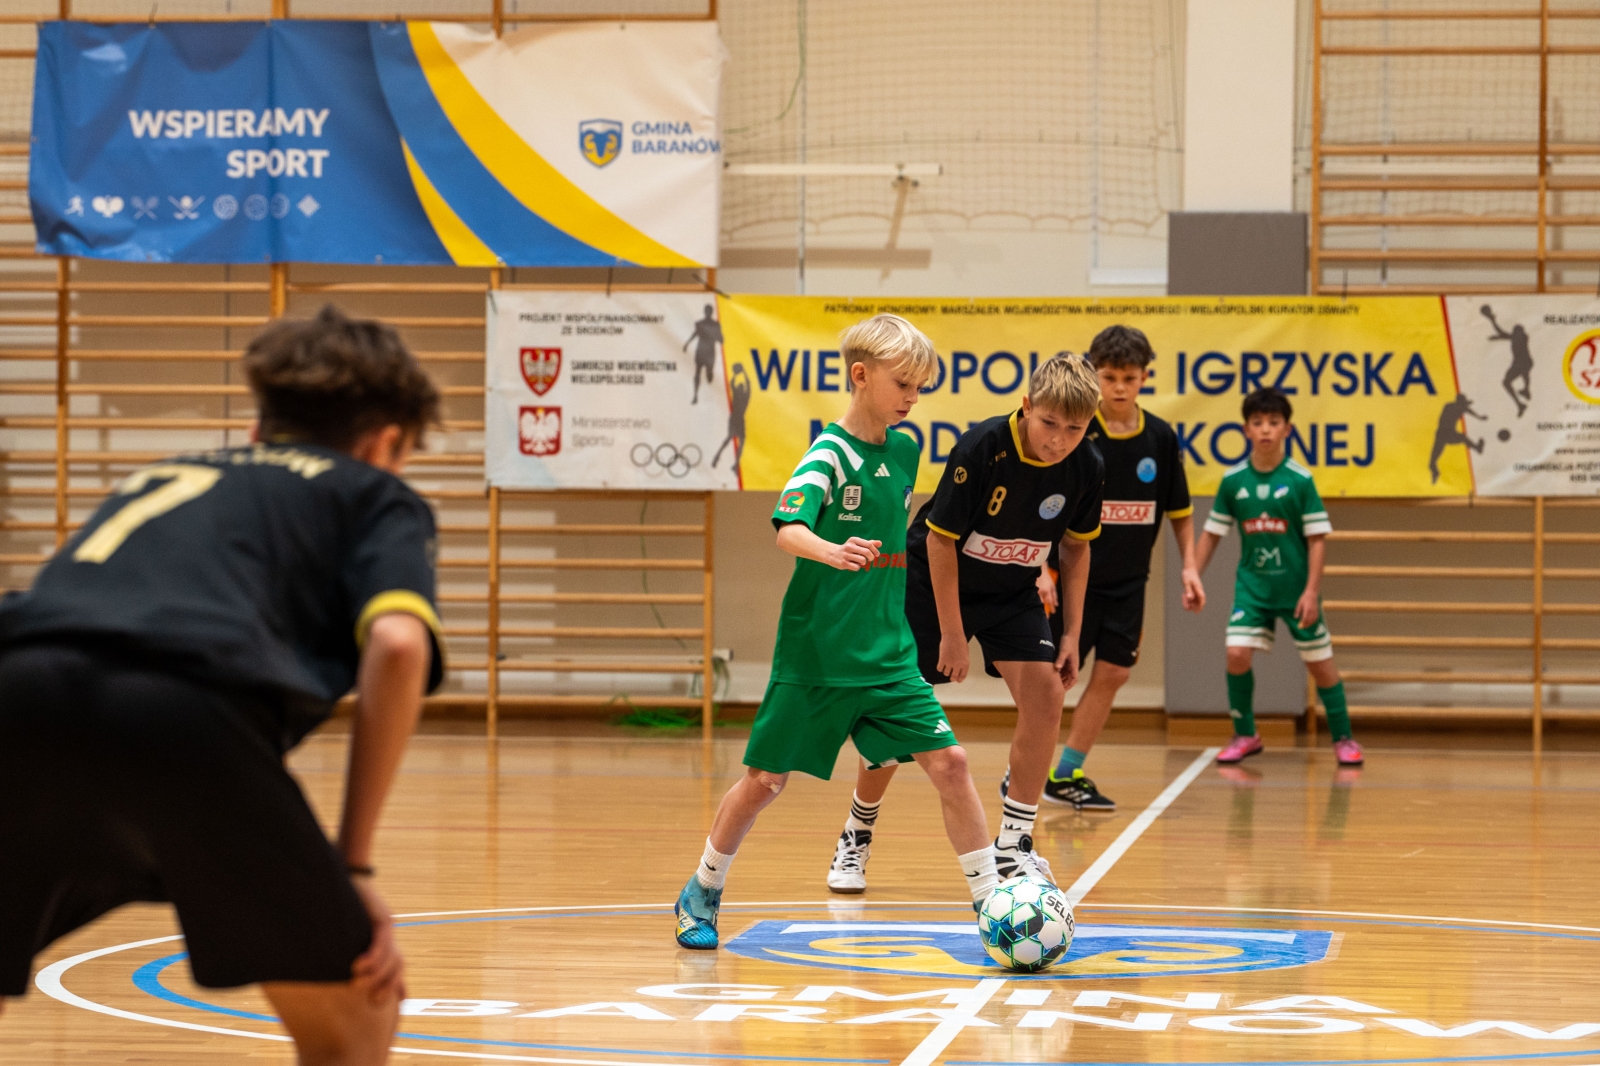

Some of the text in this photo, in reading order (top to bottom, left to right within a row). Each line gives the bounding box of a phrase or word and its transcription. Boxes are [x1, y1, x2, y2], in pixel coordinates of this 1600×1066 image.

[128, 107, 330, 139] WSPIERAMY
[631, 121, 693, 136] GMINA
[226, 149, 330, 178] SPORT
[1177, 351, 1437, 396] IGRZYSKA
[571, 416, 651, 429] Ministerstwo
[572, 433, 614, 448] Sportu
[73, 463, 222, 564] 7
[987, 486, 1007, 516] 8
[838, 513, 862, 521] Kalisz
[972, 538, 1044, 564] STOLAR
[636, 983, 1397, 1014] GMINA
